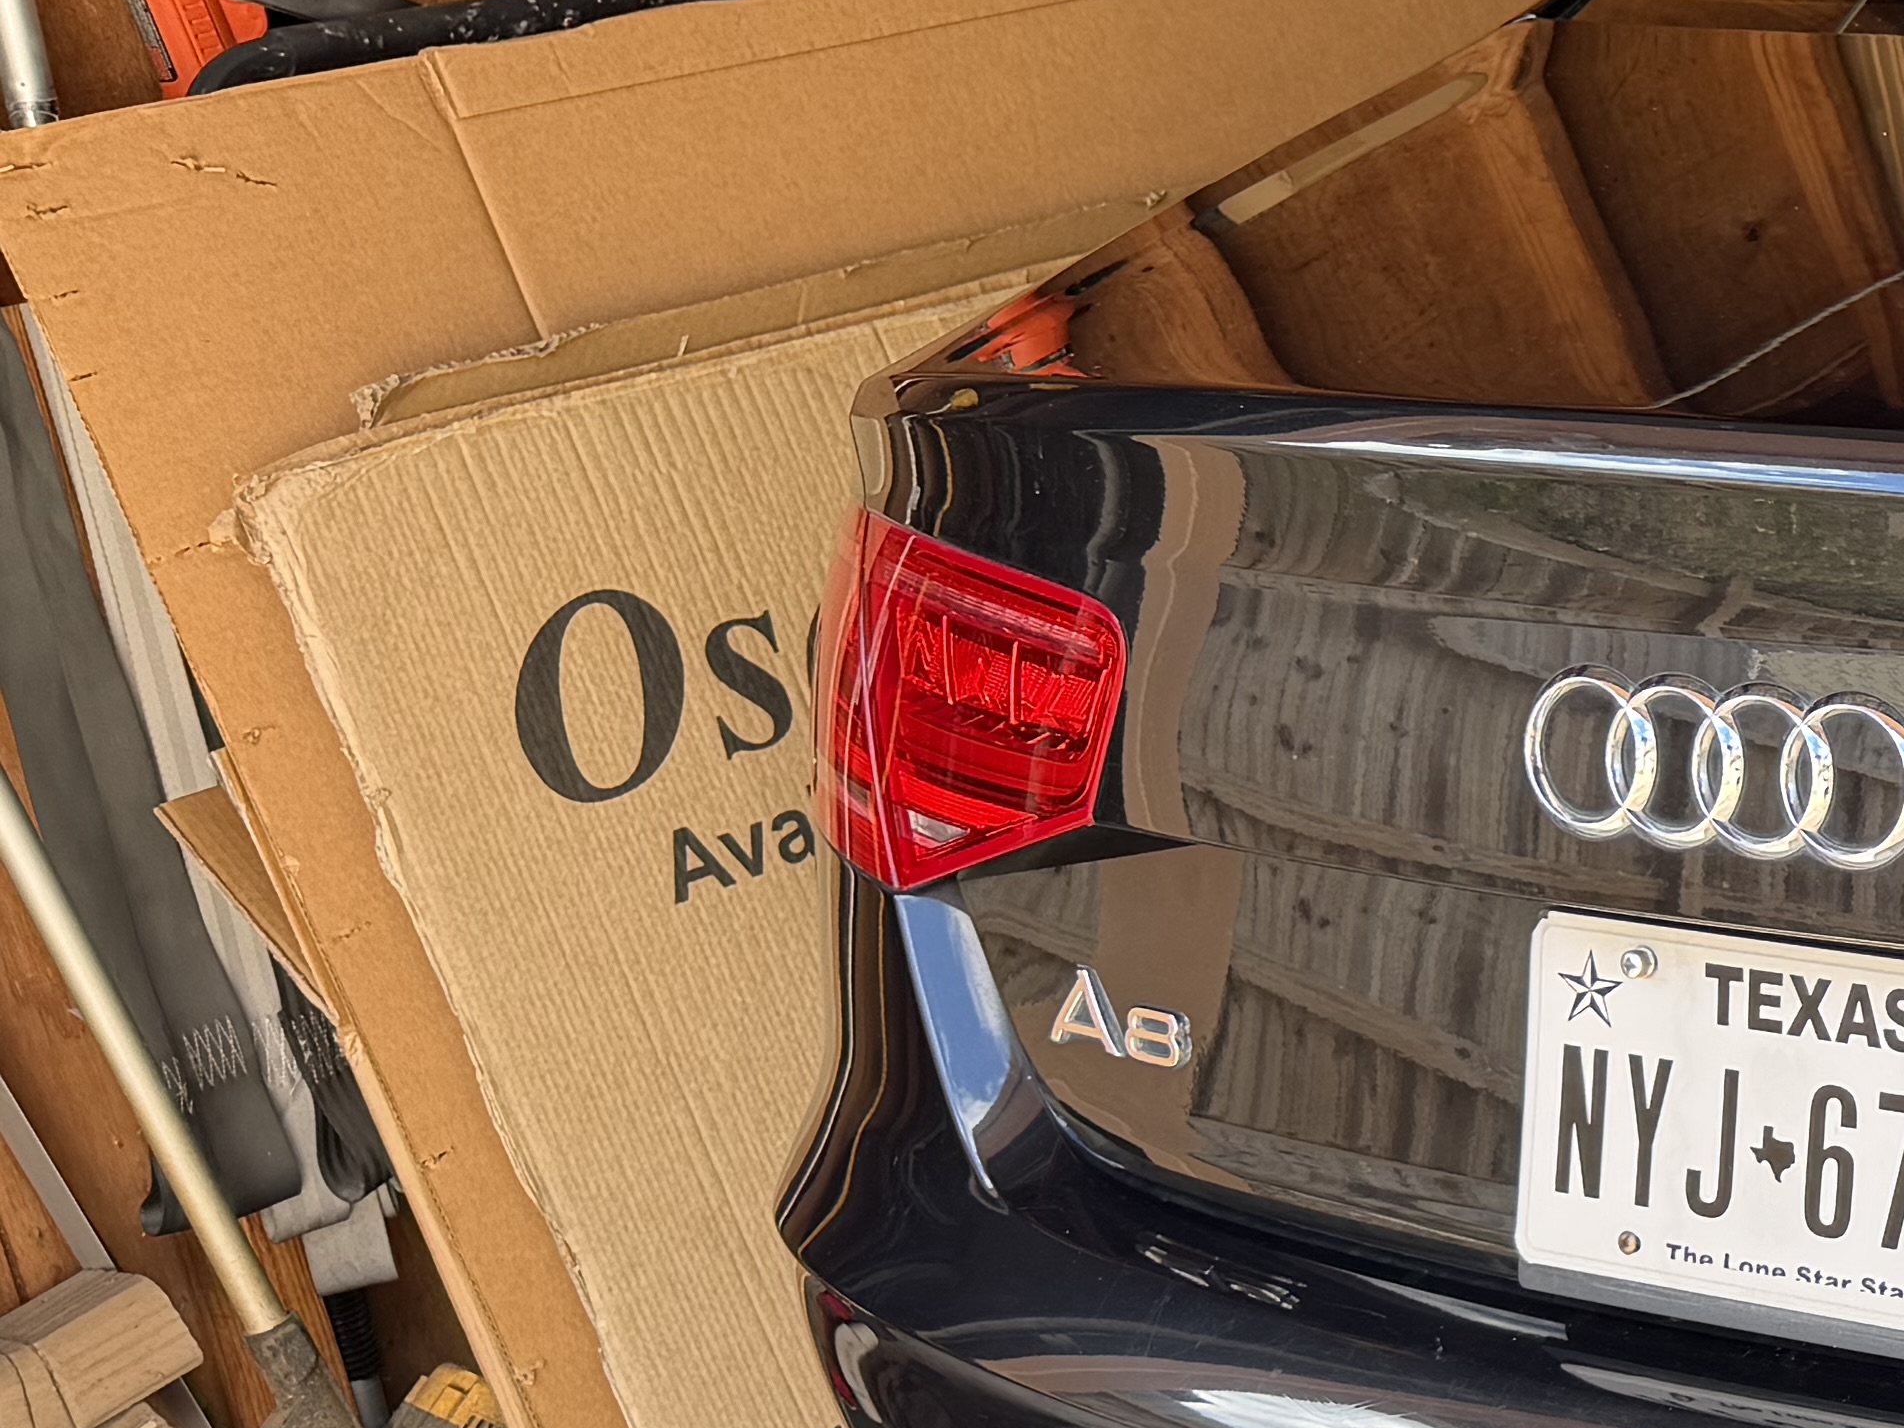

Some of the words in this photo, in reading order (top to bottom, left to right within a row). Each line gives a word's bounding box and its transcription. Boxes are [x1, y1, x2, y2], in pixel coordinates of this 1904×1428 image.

[515, 588, 821, 804] Os
[673, 809, 816, 905] Ava
[1049, 965, 1194, 1072] A8
[1666, 1242, 1714, 1265] The
[1724, 1252, 1787, 1278] Lone
[1796, 1265, 1852, 1290] Star
